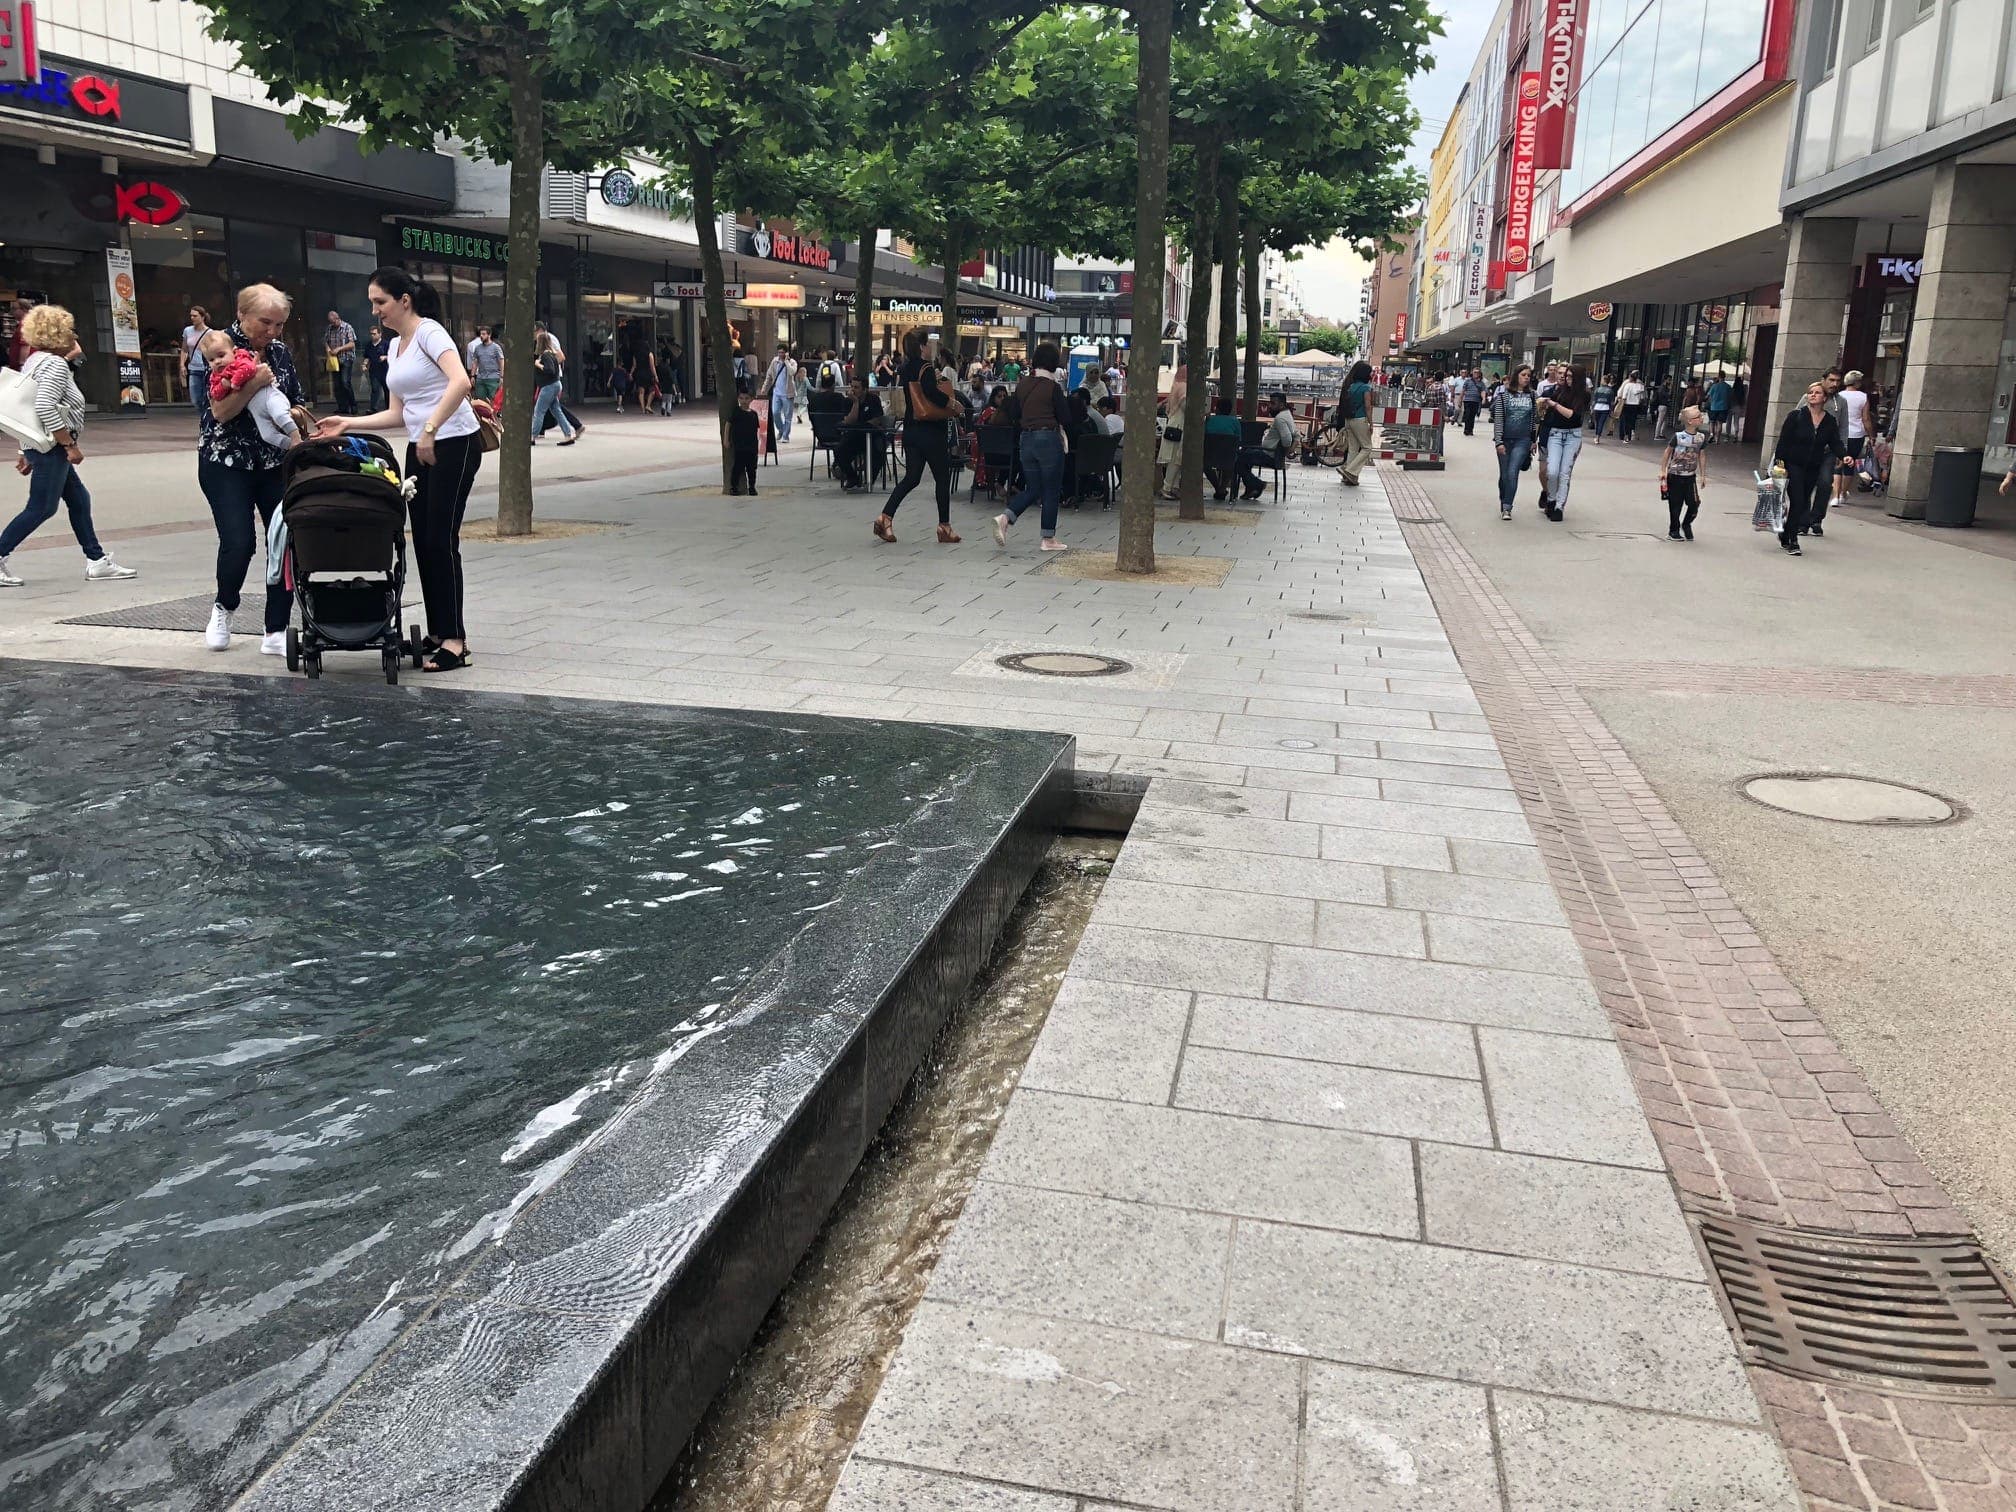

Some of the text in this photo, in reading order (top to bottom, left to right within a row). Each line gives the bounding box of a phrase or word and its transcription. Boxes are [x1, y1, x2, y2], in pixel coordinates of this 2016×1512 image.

[1511, 105, 1537, 240] BURGER KING
[1475, 208, 1485, 239] HARIG
[402, 227, 491, 259] STARBUCKS
[771, 230, 832, 268] Foot Locker
[678, 285, 699, 296] Foot
[1469, 259, 1480, 296] JOCHUM
[873, 314, 919, 322] FITNESS
[1590, 306, 1610, 317] KING
[120, 367, 141, 376] SUSHI
